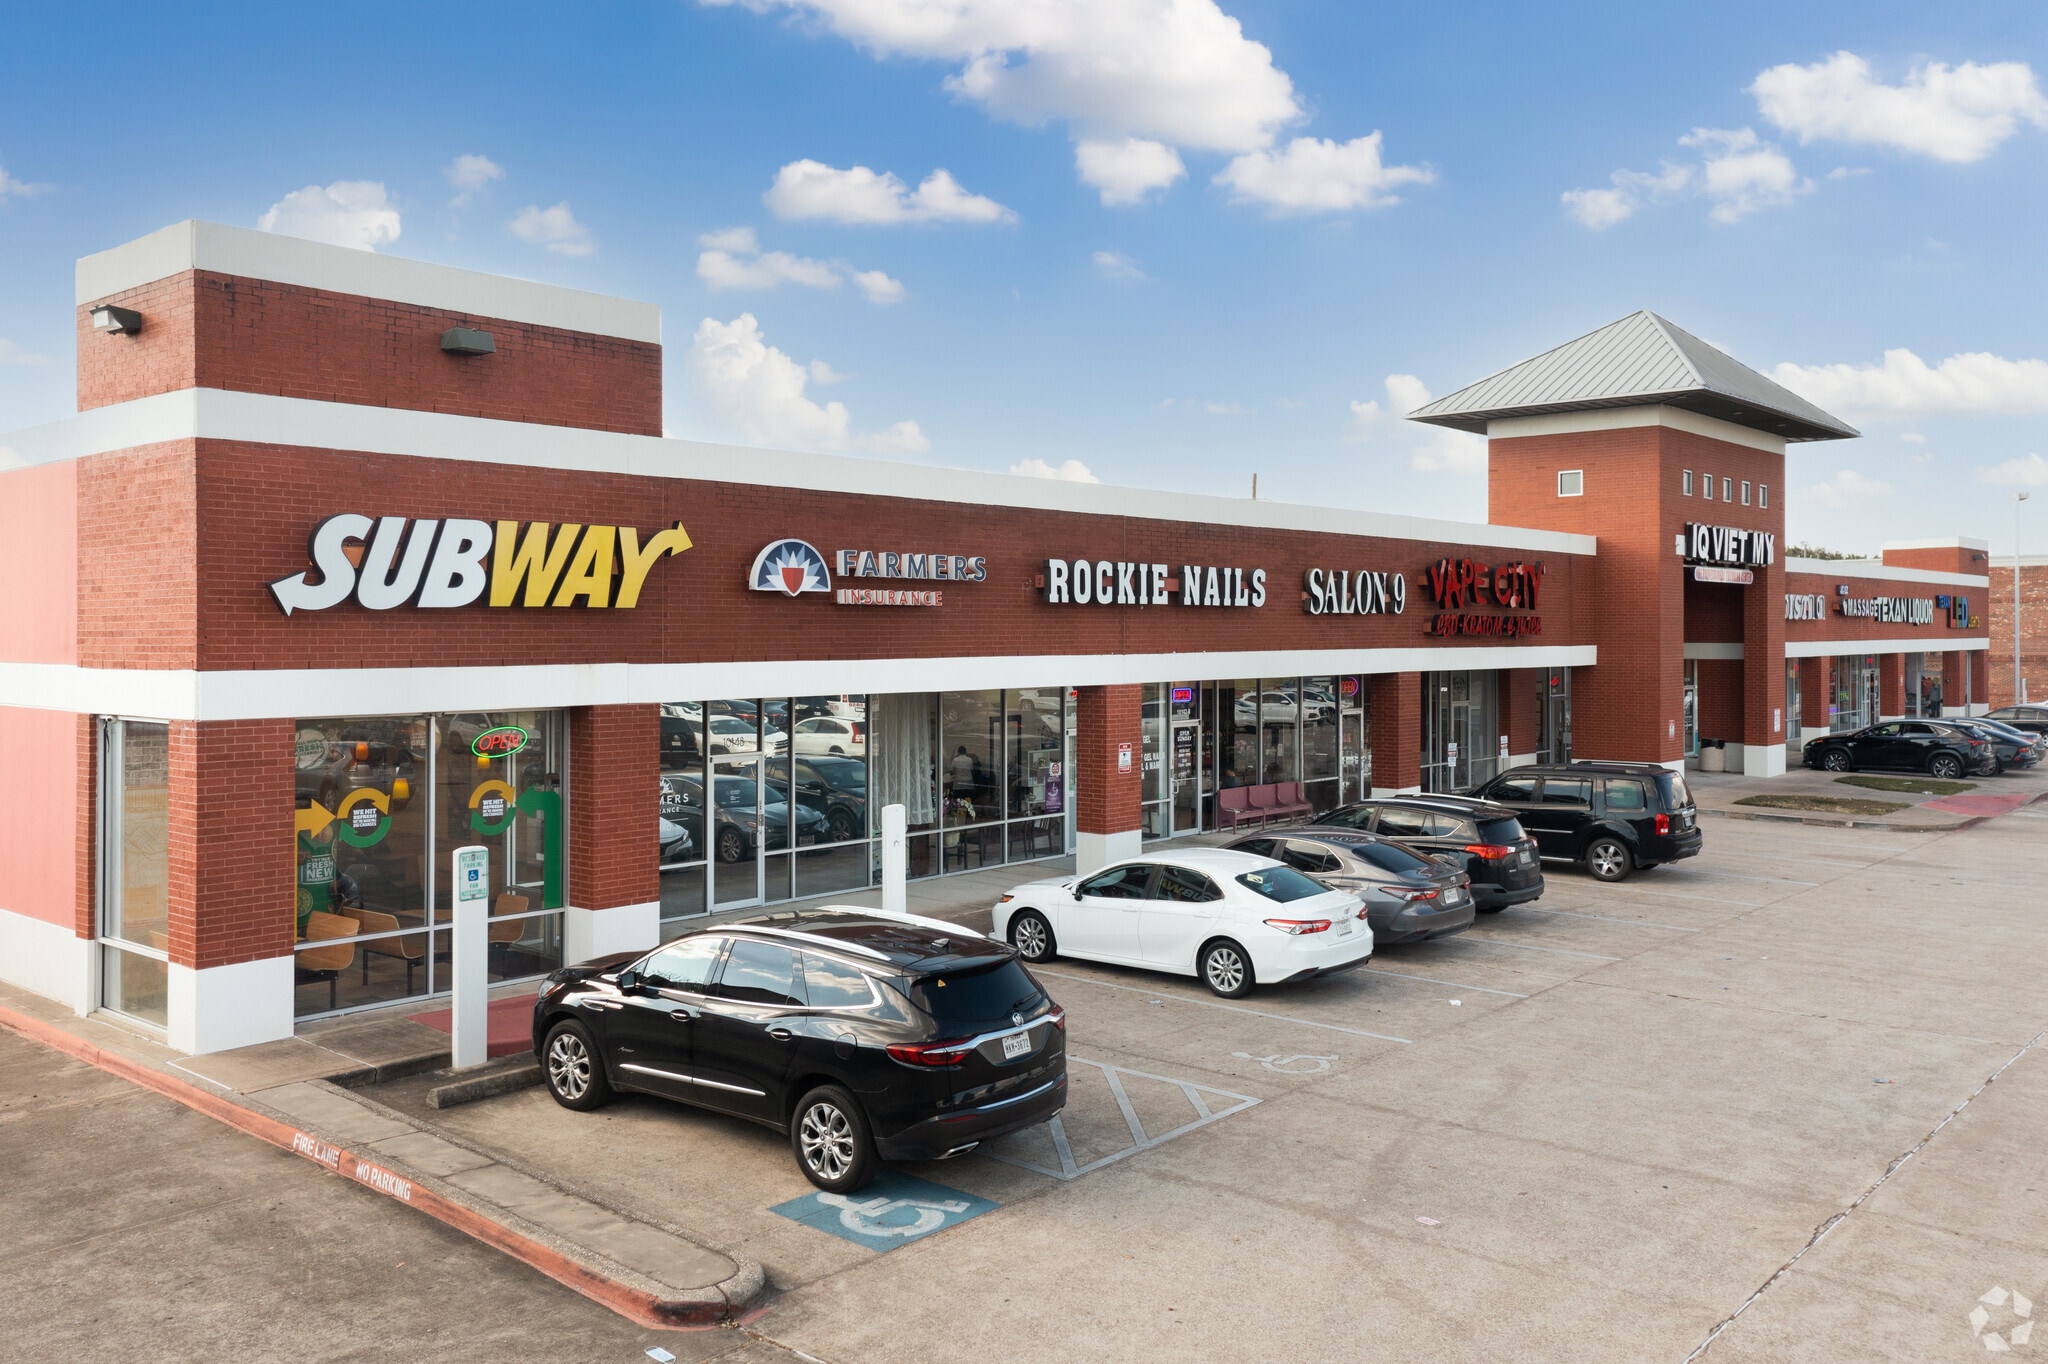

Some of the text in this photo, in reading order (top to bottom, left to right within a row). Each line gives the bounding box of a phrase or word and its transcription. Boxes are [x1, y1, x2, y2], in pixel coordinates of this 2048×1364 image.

[1692, 524, 1774, 564] IQ VIET MY
[268, 513, 693, 616] SUBWAY
[838, 550, 986, 582] FARMERS
[838, 589, 942, 606] INSURANCE
[1046, 559, 1266, 607] ROCKIE NAILS
[1306, 568, 1405, 615] SALON 9
[1431, 557, 1546, 609] VAPE CITY
[1848, 598, 1878, 616] MASSAGE
[1876, 597, 1933, 626] TEXAN LIQUOR
[1950, 596, 1968, 628] LED
[1341, 681, 1355, 693] OPEN
[479, 733, 521, 750] OPEN
[306, 860, 334, 869] FRESH
[306, 867, 334, 878] NEW
[293, 1133, 340, 1168] FIRE LANE
[356, 1161, 411, 1200] NO PARKING
